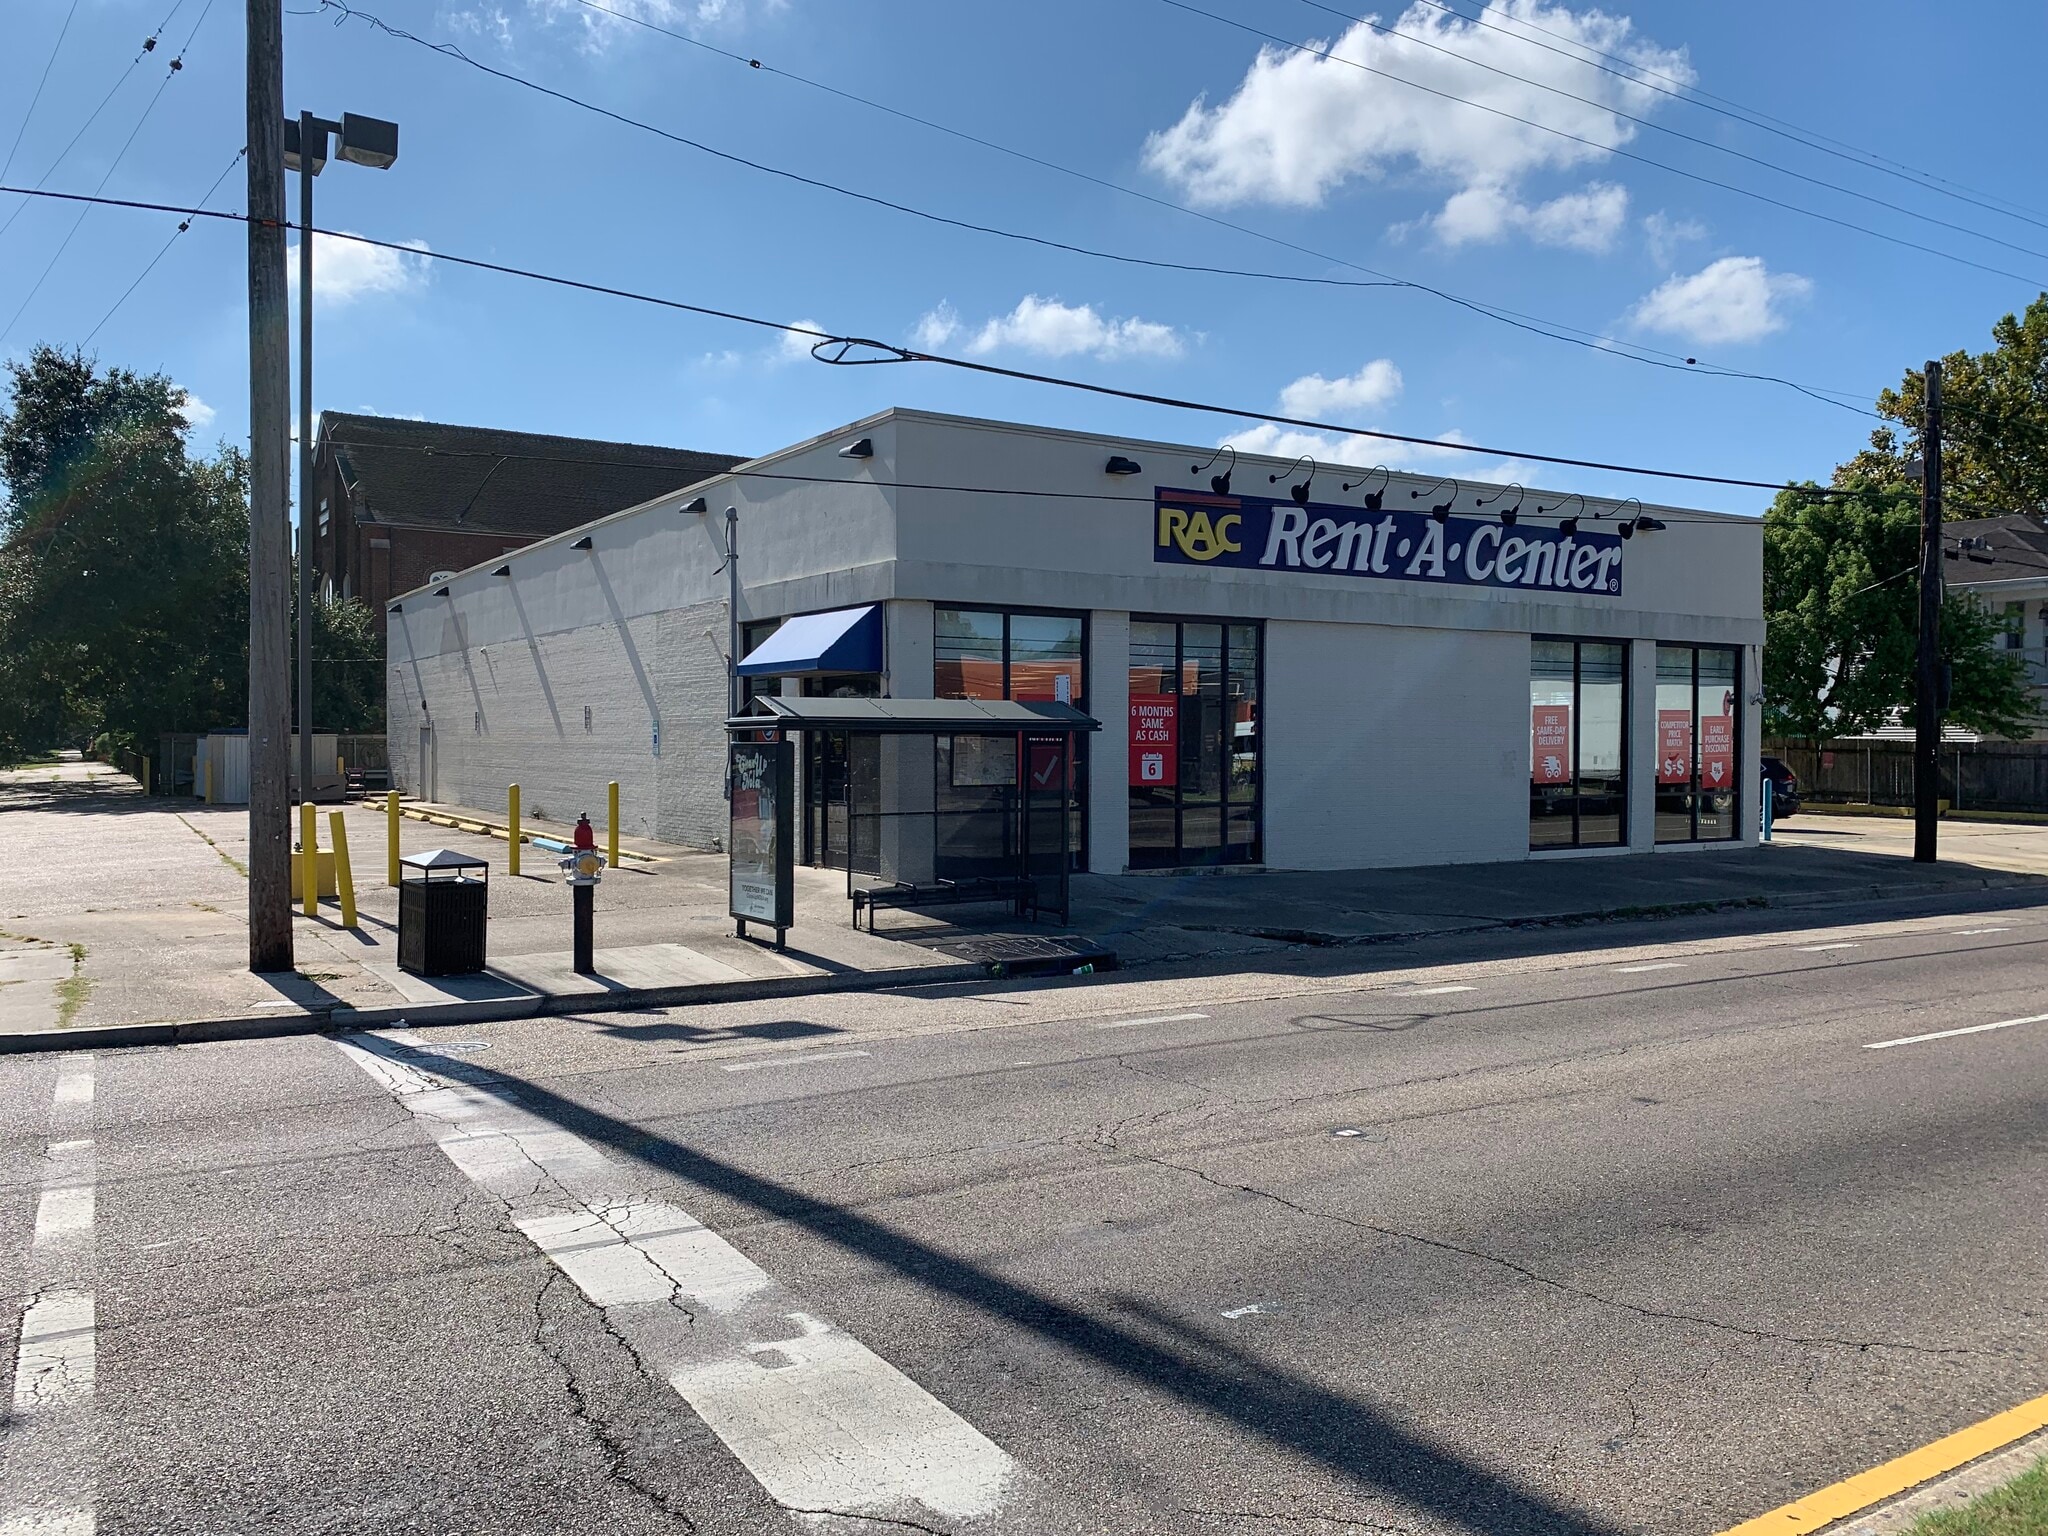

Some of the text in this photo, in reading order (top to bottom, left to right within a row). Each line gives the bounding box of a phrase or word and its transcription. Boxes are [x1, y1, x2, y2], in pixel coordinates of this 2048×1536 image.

[1158, 507, 1241, 561] RAC
[1131, 705, 1174, 717] 6 MONTHS
[1141, 718, 1164, 729] SAME
[1544, 715, 1558, 725] FREE
[1660, 720, 1690, 729] COMPETITOR
[1536, 725, 1567, 736] SAME-DAY
[1668, 729, 1682, 738] PRICE
[1710, 725, 1725, 734] EARLY
[1135, 730, 1169, 741] AS CASH
[1704, 734, 1730, 744] PURCHASE
[1538, 736, 1564, 746] DELIVERY
[1666, 738, 1683, 747] MATCH
[1705, 744, 1730, 753] DISCOUNT
[1148, 762, 1156, 776] 6
